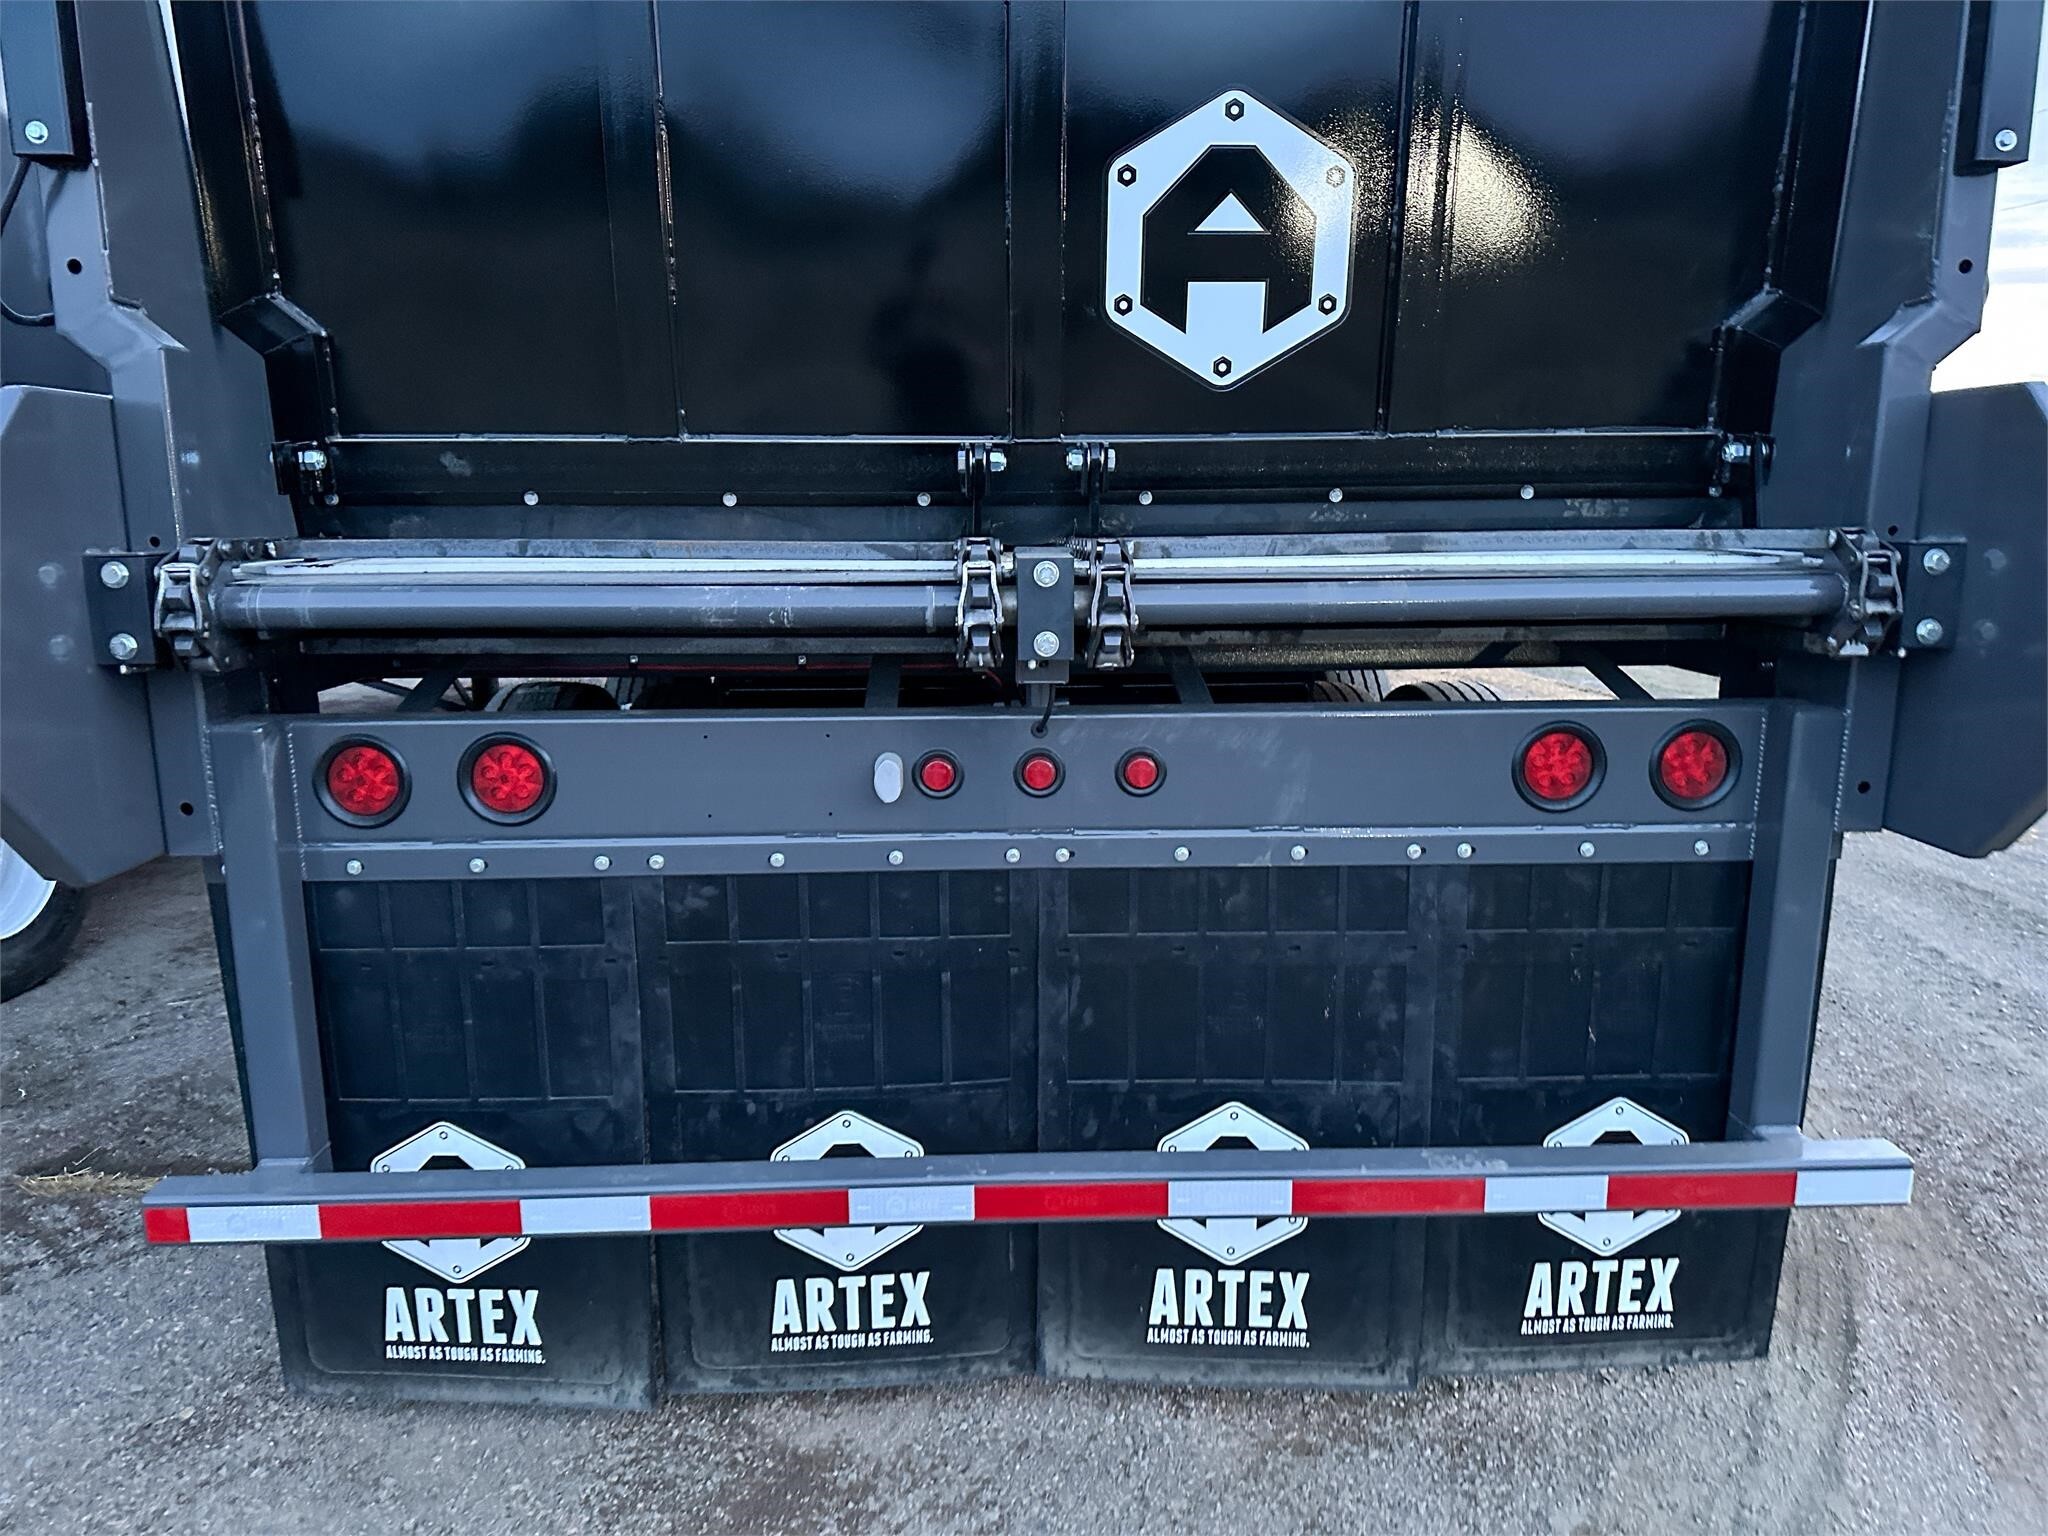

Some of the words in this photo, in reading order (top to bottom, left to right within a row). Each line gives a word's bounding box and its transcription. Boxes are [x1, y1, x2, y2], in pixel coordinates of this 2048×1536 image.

[772, 1271, 931, 1334] ARTEX
[1148, 1268, 1310, 1329] ARTEX
[1524, 1258, 1680, 1317] ARTEX
[385, 1287, 543, 1345] ARTEX
[1520, 1319, 1561, 1335] ALMOST
[1562, 1318, 1576, 1333] AS
[1578, 1316, 1610, 1332] TOUGH
[1612, 1316, 1625, 1331] AS
[1626, 1314, 1674, 1330] FARMING.
[386, 1346, 426, 1360] ALMOST
[429, 1347, 443, 1360] AS
[444, 1347, 479, 1362] TOUGH
[480, 1348, 494, 1362] AS
[495, 1348, 546, 1364] FARMING.
[771, 1336, 813, 1352] ALMOST
[815, 1336, 829, 1350] AS
[831, 1334, 865, 1349] TOUGH
[867, 1332, 881, 1347] AS
[883, 1330, 934, 1346] FARMING.
[1146, 1328, 1189, 1344] ALMOST
[1191, 1329, 1205, 1345] AS
[1208, 1330, 1241, 1345] TOUGH
[1243, 1331, 1257, 1346] AS
[1259, 1331, 1310, 1348] FARMING.
